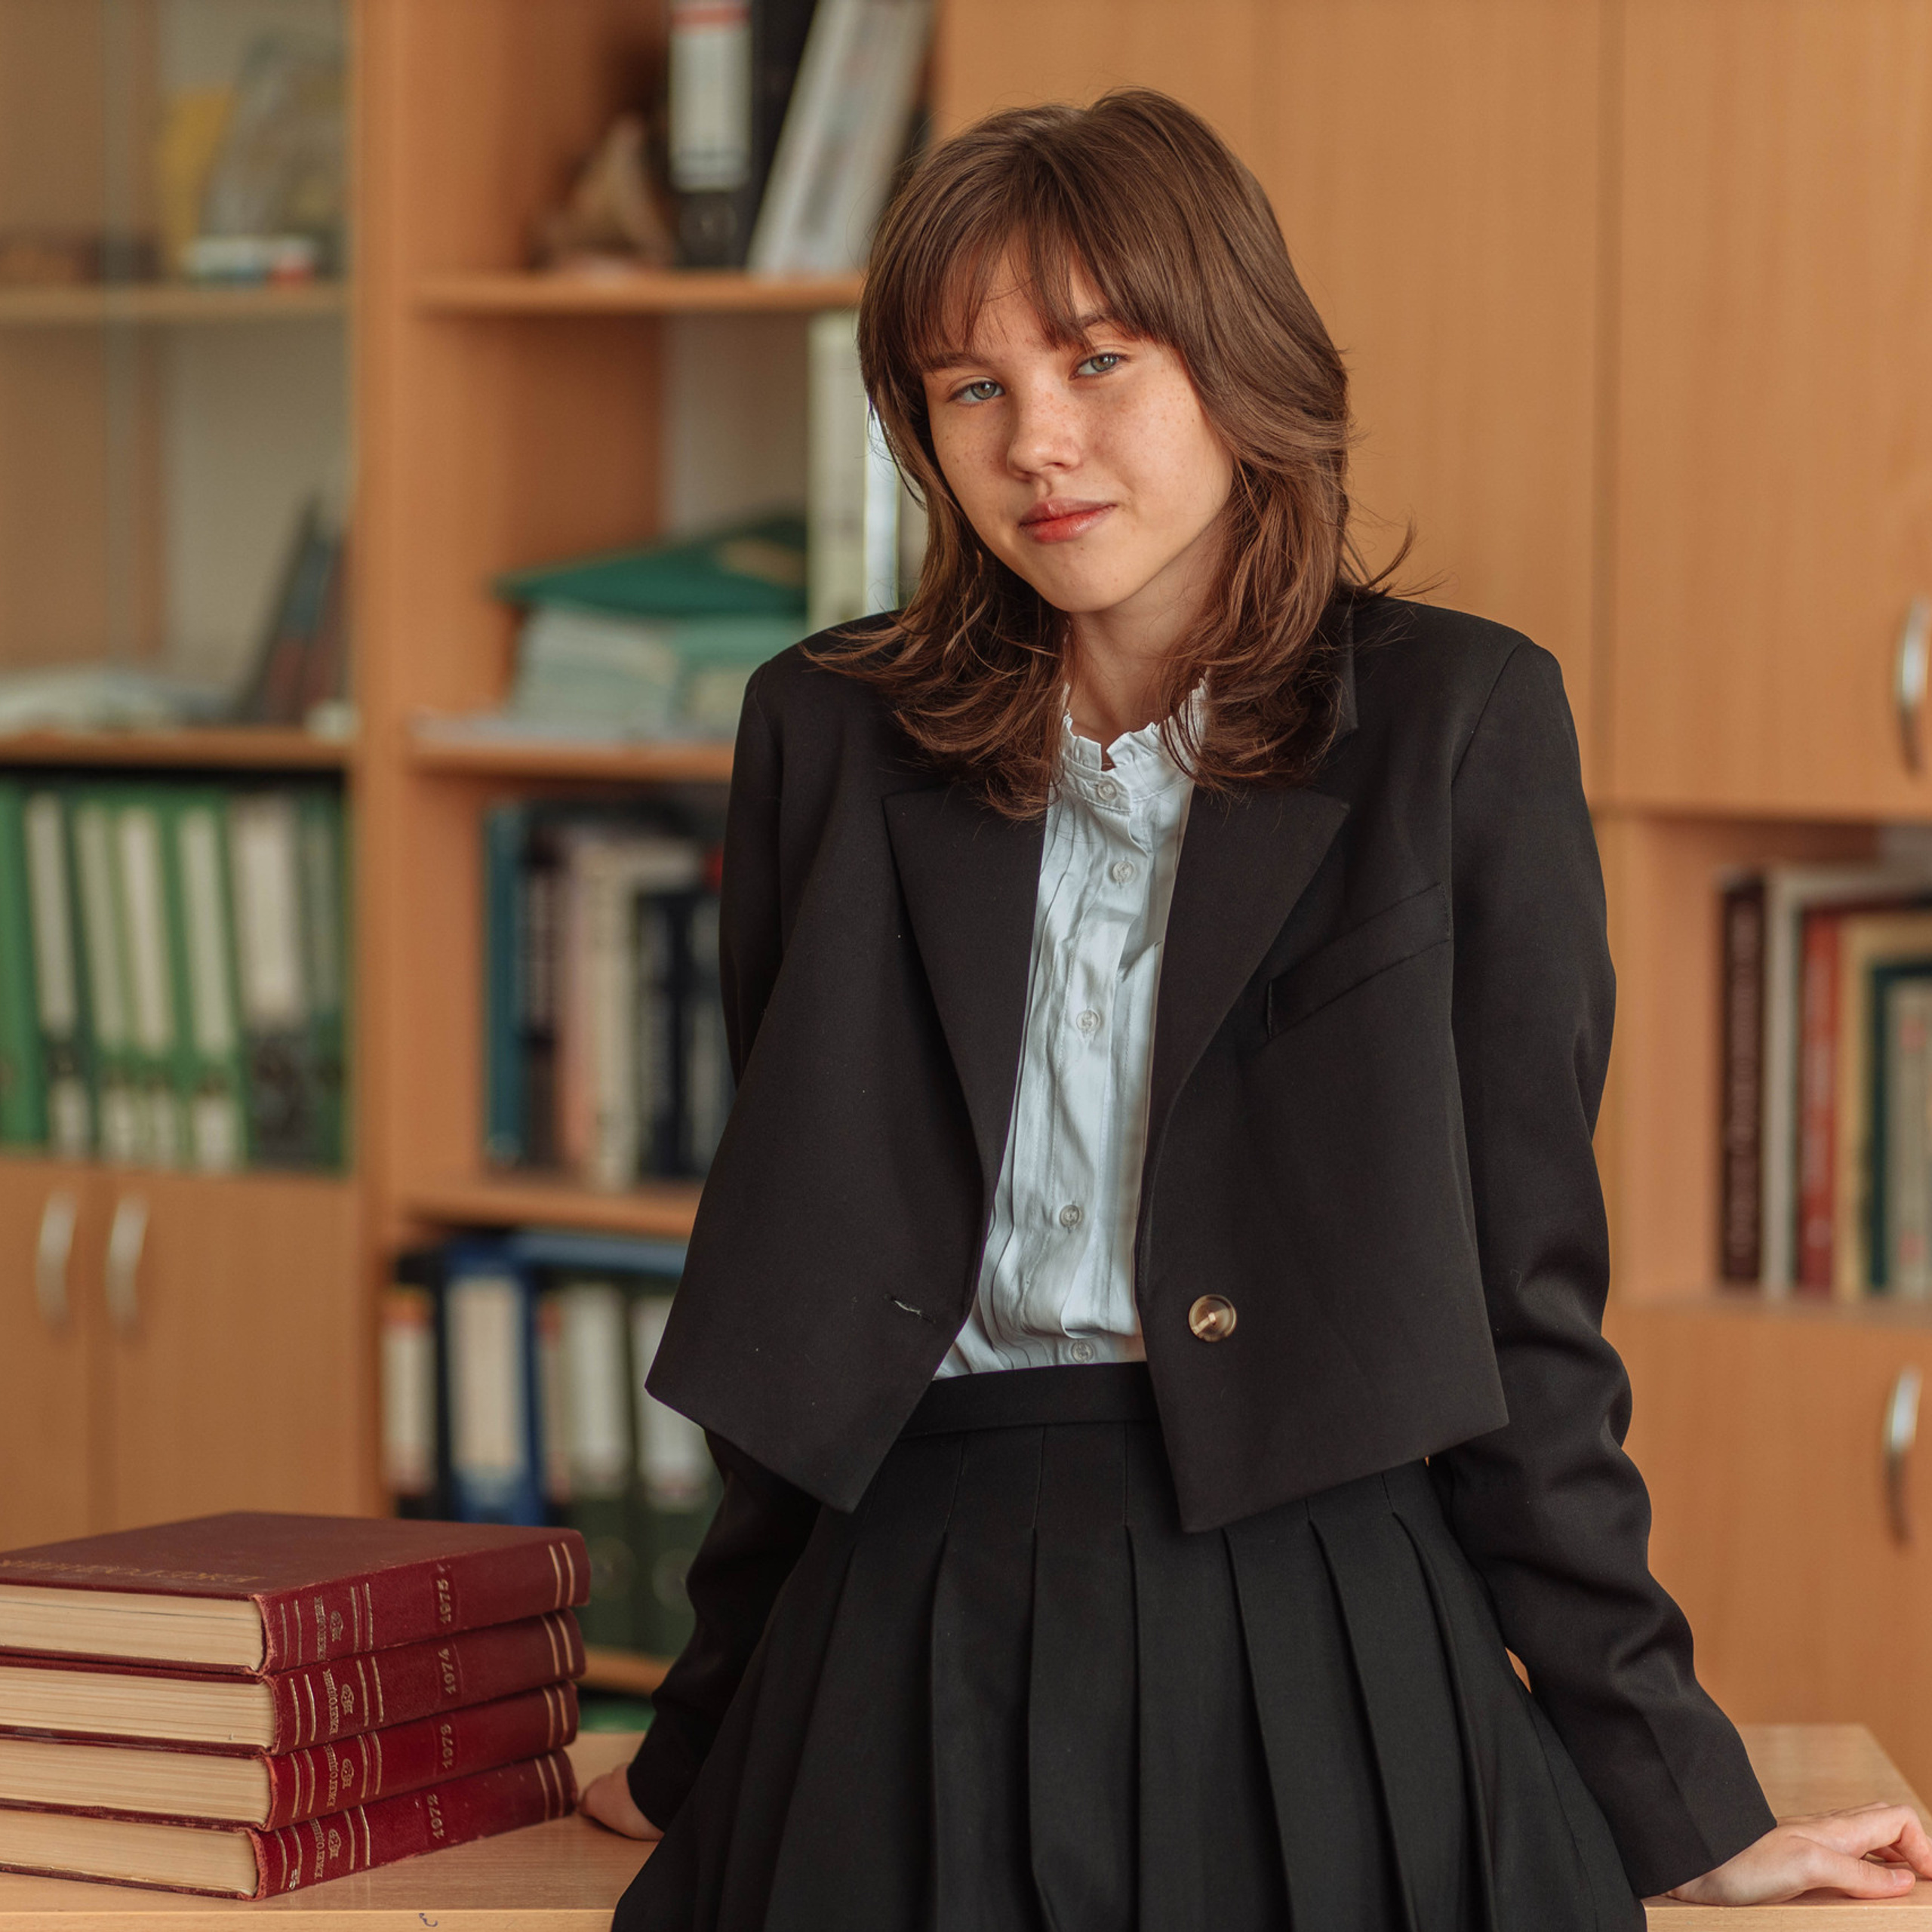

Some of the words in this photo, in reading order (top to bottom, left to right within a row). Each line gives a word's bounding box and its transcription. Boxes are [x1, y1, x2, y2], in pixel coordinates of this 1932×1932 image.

[436, 1579, 451, 1624] 1975
[438, 1647, 456, 1694] 1974
[439, 1723, 454, 1769] 1973
[426, 1793, 445, 1838] 1972
